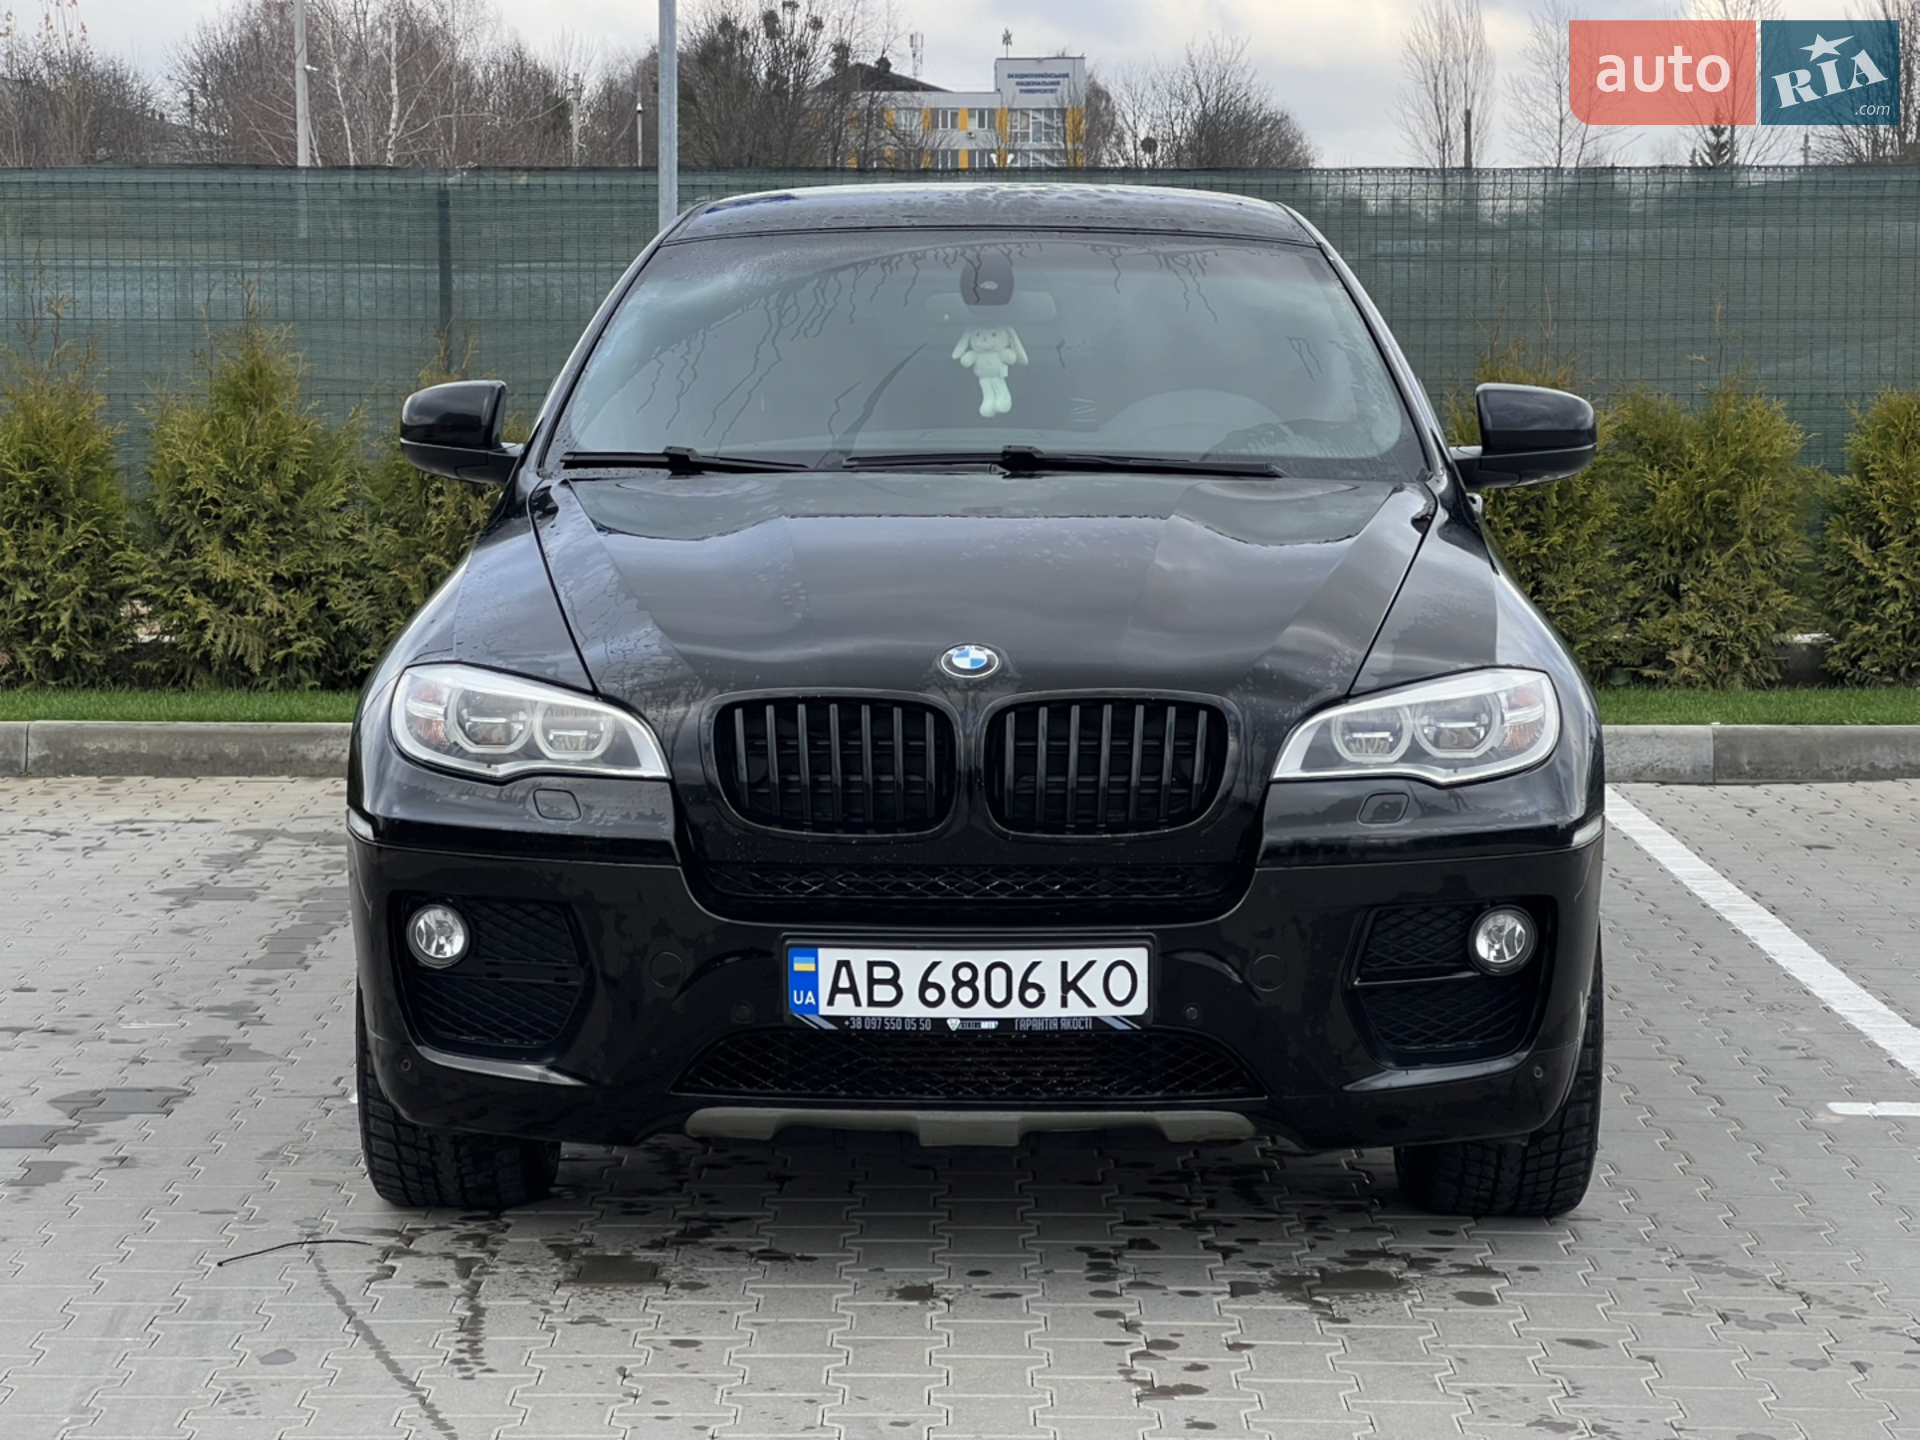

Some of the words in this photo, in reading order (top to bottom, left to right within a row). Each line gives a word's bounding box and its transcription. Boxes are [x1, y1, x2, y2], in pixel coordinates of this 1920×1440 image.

[826, 959, 903, 1008] AB
[917, 960, 1046, 1010] 6806
[1060, 959, 1138, 1009] KO
[794, 991, 816, 1005] UA
[844, 1017, 862, 1030] +38
[864, 1017, 882, 1030] 097
[884, 1018, 901, 1030] 550
[904, 1018, 917, 1030] 05
[919, 1018, 932, 1031] 50
[1014, 1017, 1058, 1031] ГАРАНТІЯ
[1060, 1017, 1093, 1030] ЯКОСТІ
